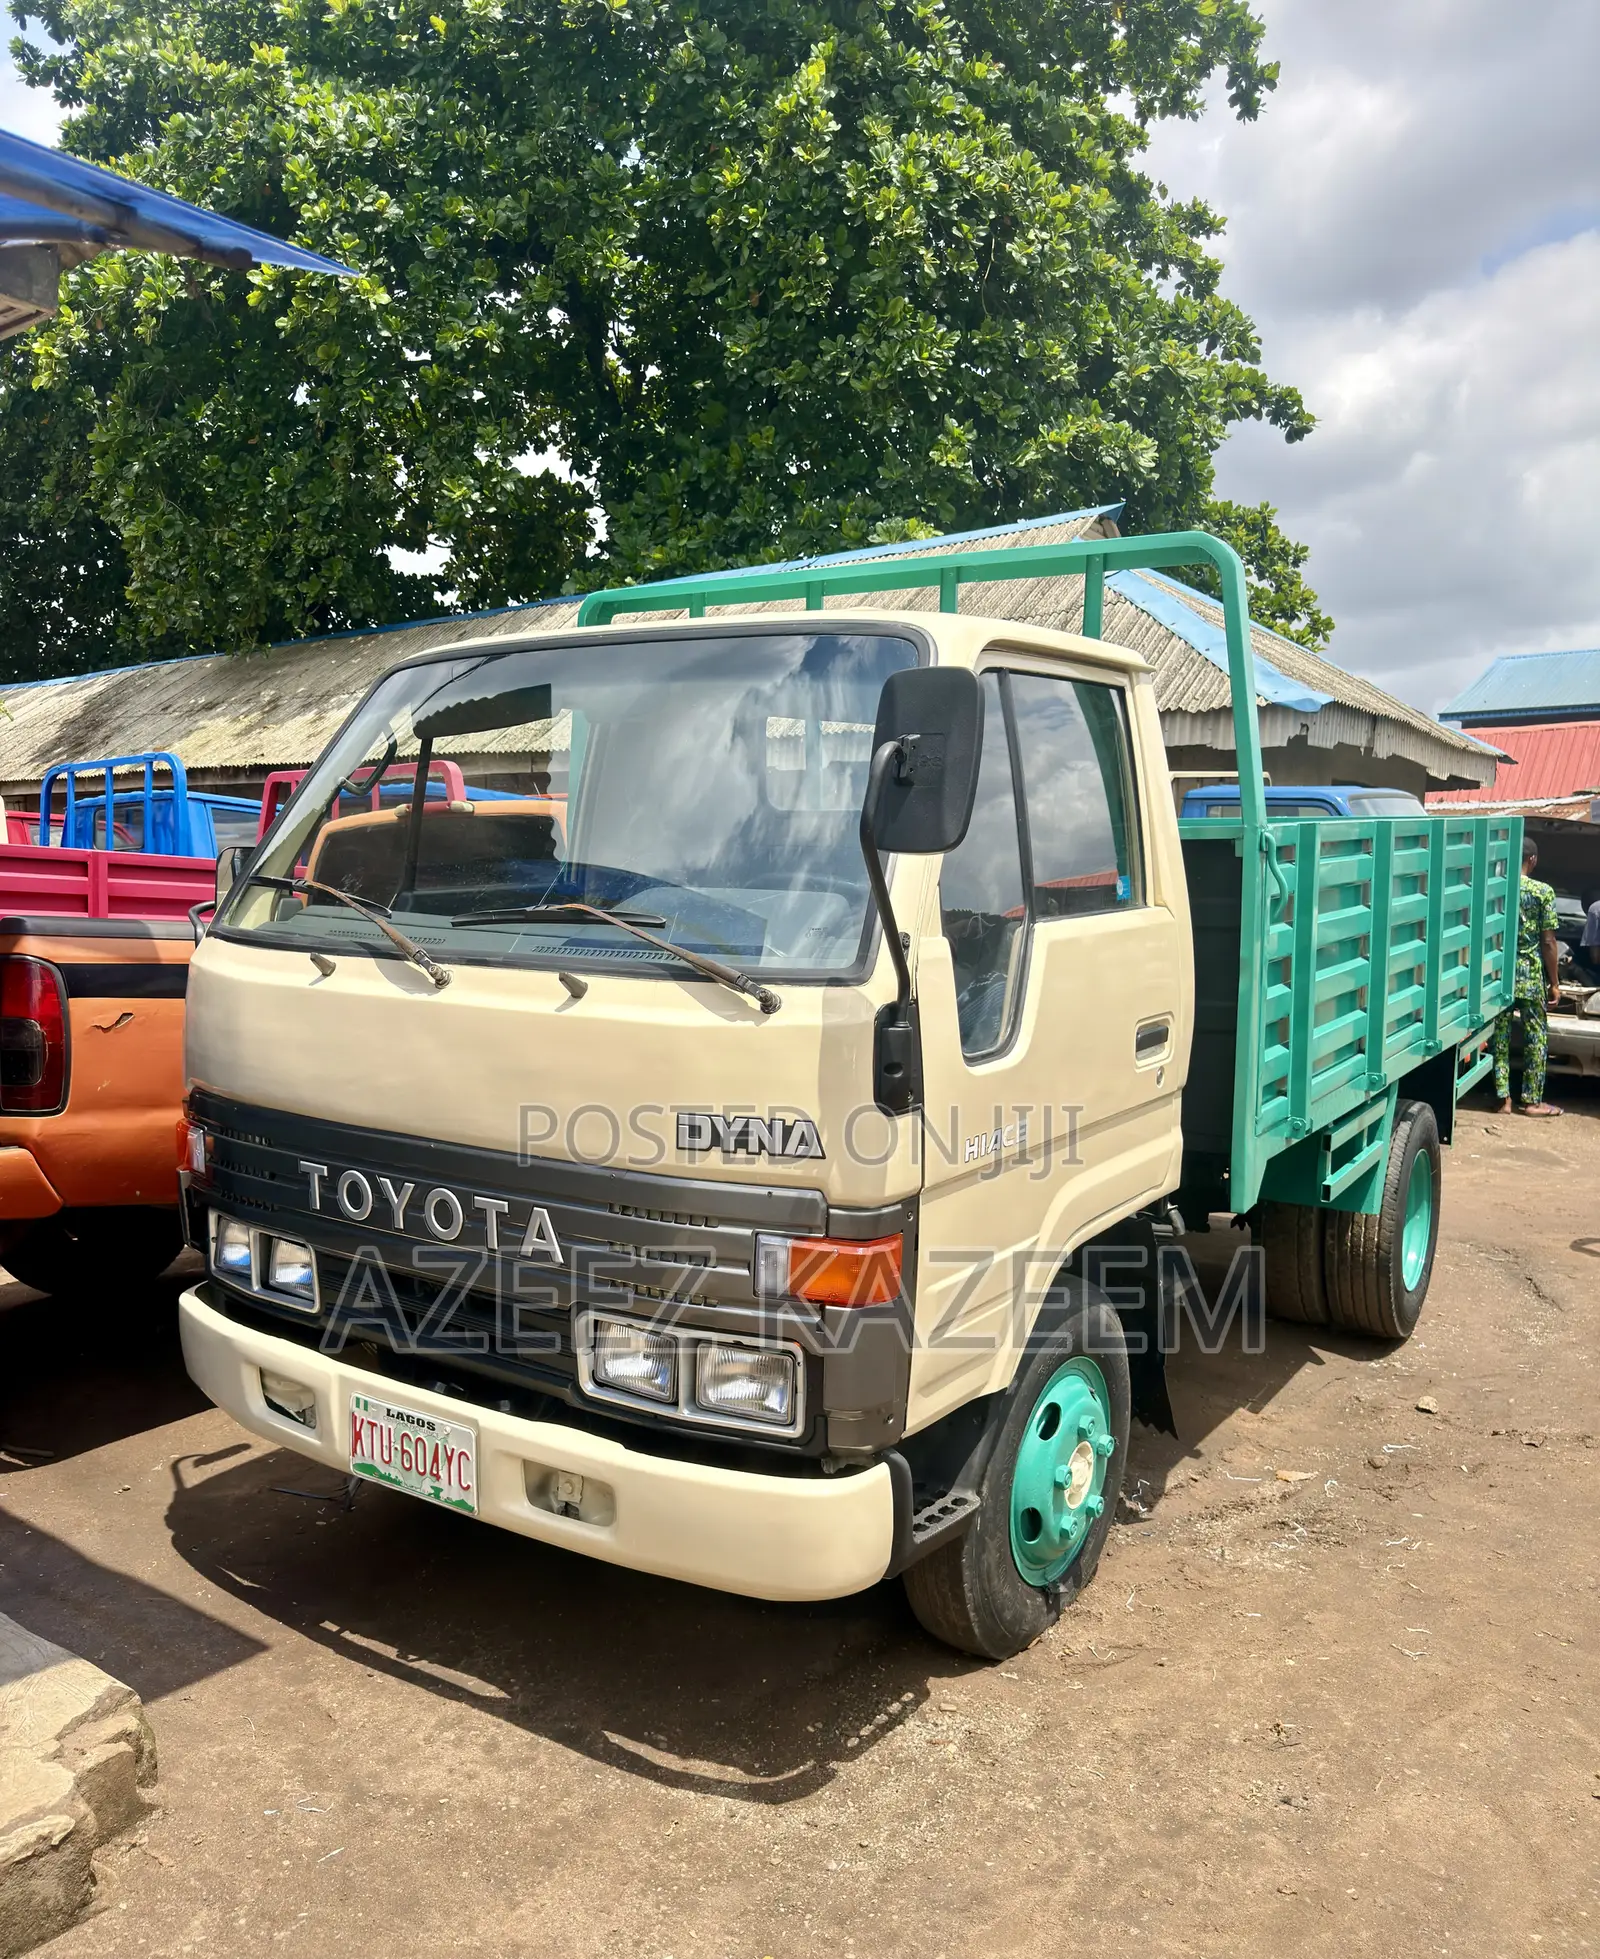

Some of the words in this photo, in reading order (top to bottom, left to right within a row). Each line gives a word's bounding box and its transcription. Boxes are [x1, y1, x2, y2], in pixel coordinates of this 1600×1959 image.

[677, 1112, 826, 1159] DYNA
[964, 1118, 1027, 1163] HIACE
[299, 1160, 565, 1266] TOYOTA
[386, 1408, 436, 1431] LAGOS
